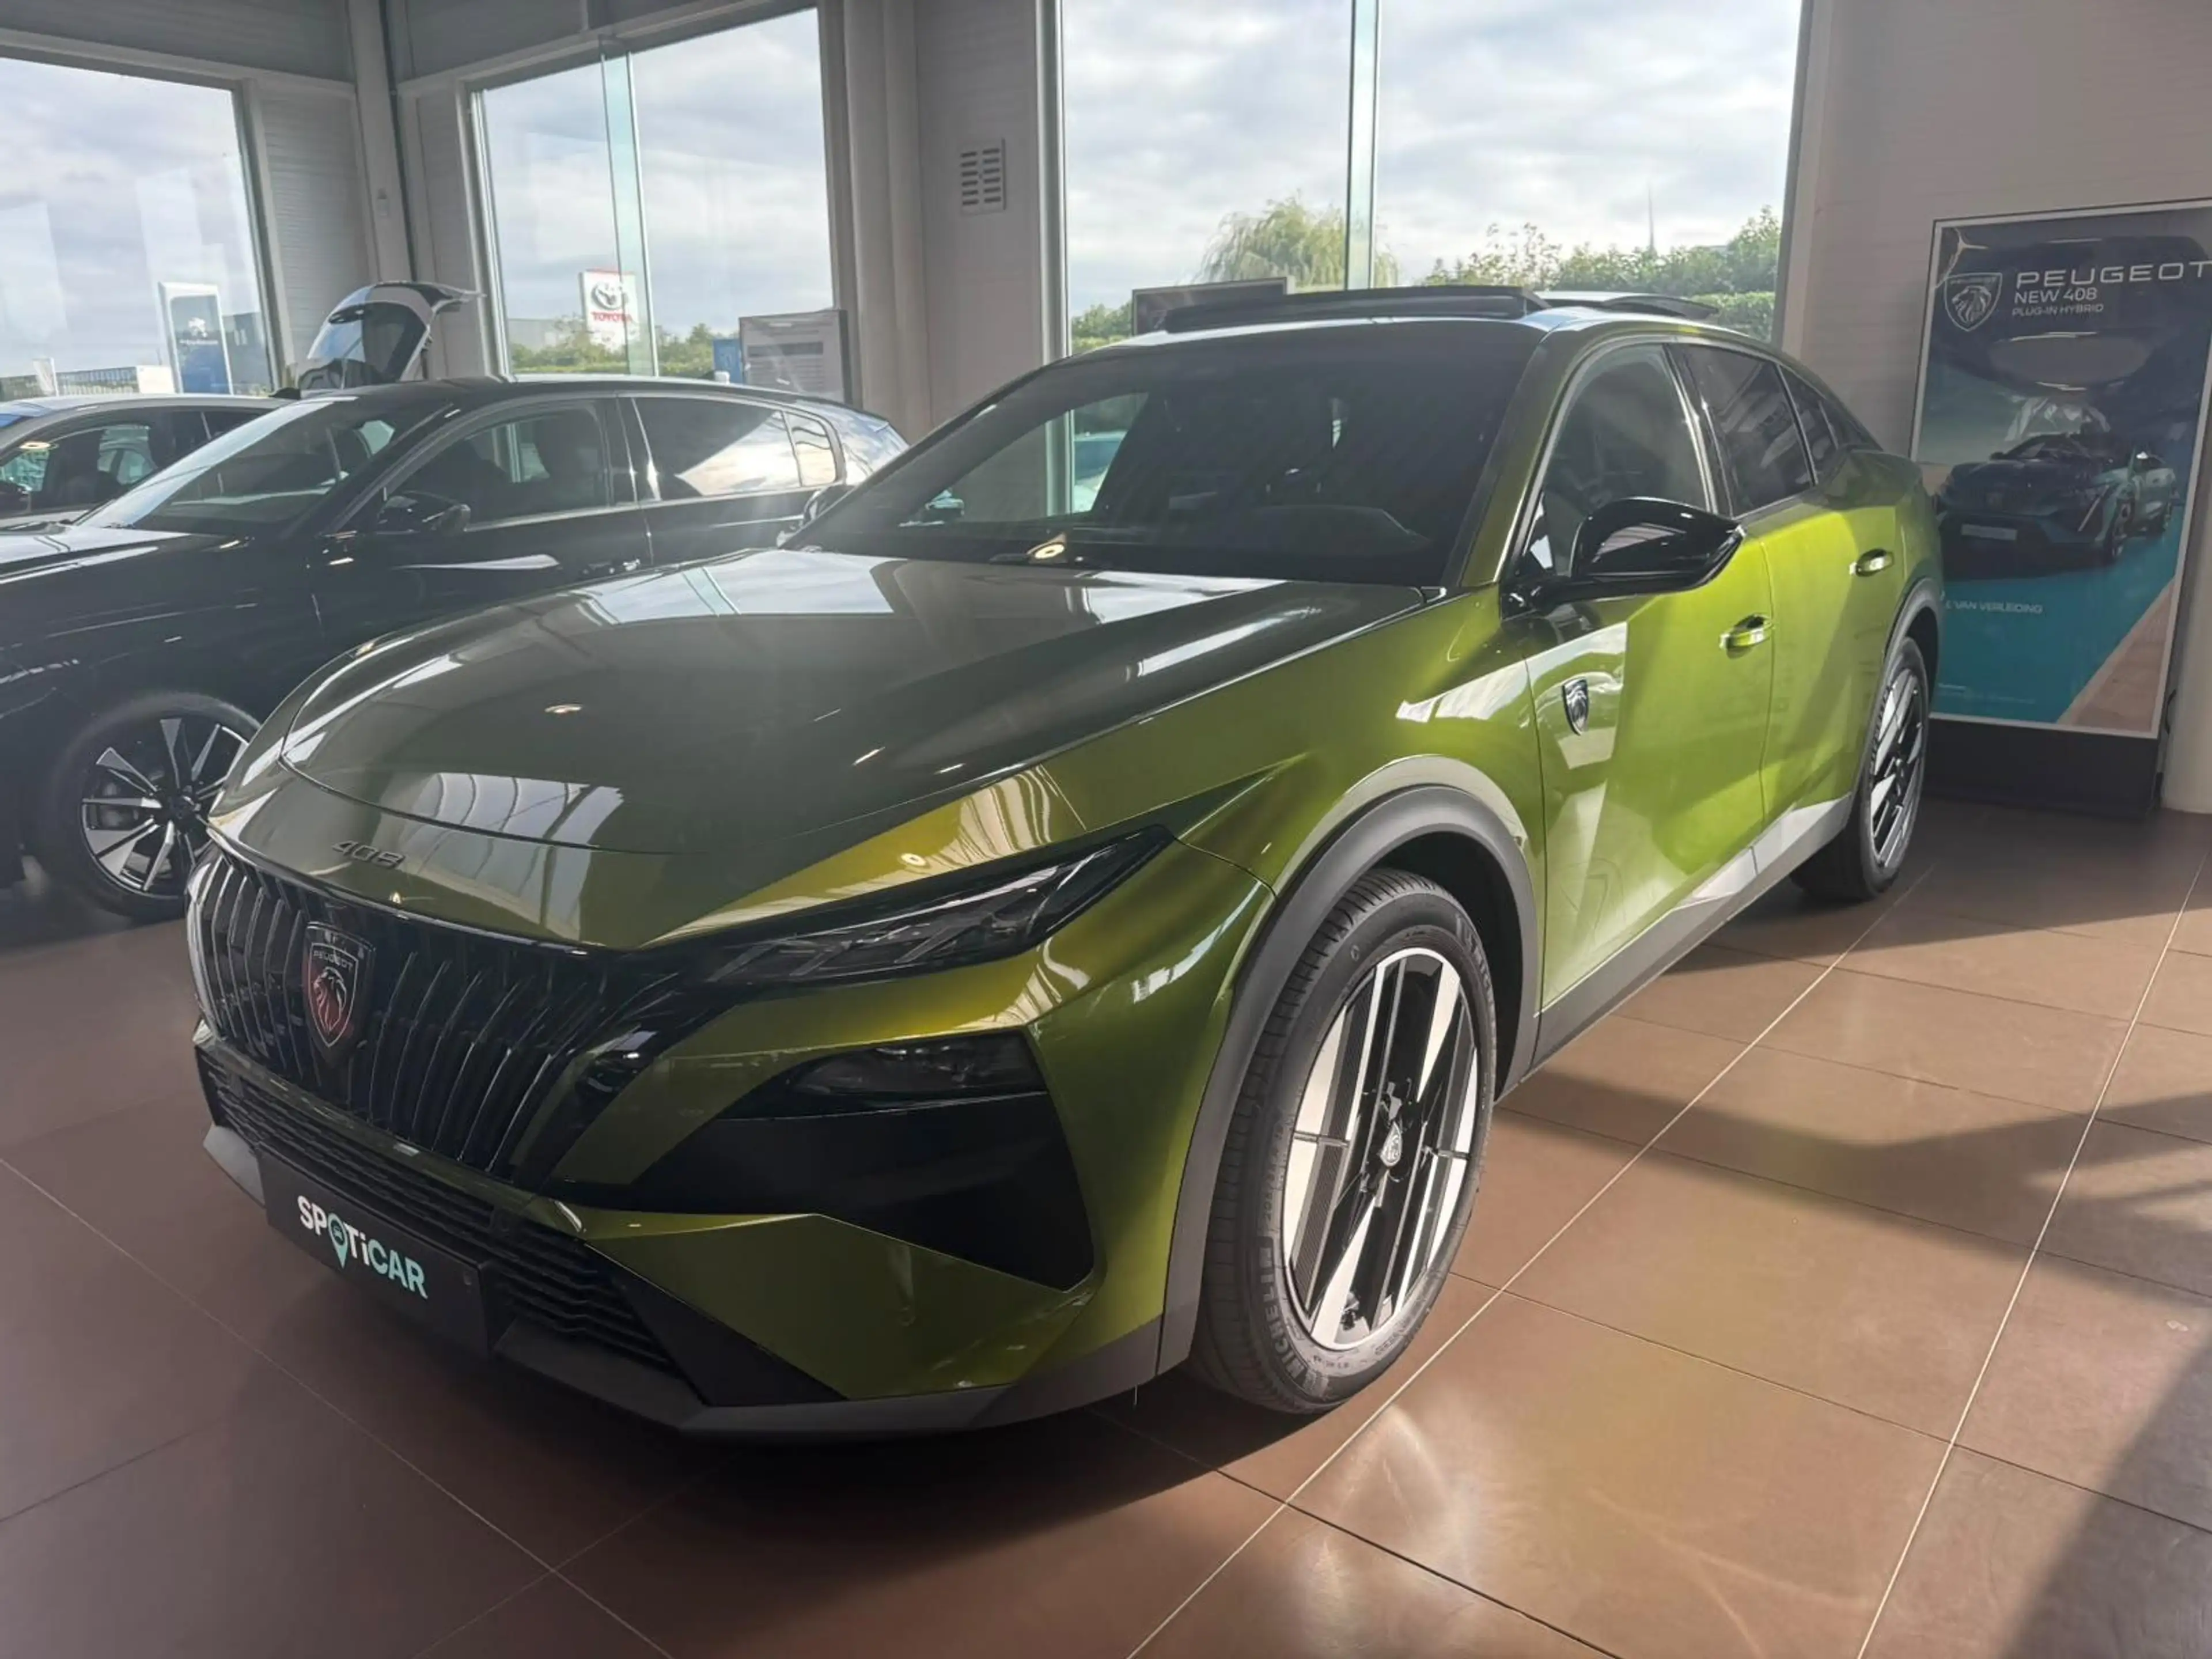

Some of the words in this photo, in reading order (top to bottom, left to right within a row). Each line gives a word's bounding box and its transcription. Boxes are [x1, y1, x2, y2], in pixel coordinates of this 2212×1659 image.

[2016, 261, 2212, 289] PEUGEOT
[2014, 289, 2060, 304] NEW
[2063, 287, 2098, 301] 408
[591, 312, 633, 323] TOYOTA
[2059, 304, 2104, 315] HYBRID
[332, 840, 405, 868] 408
